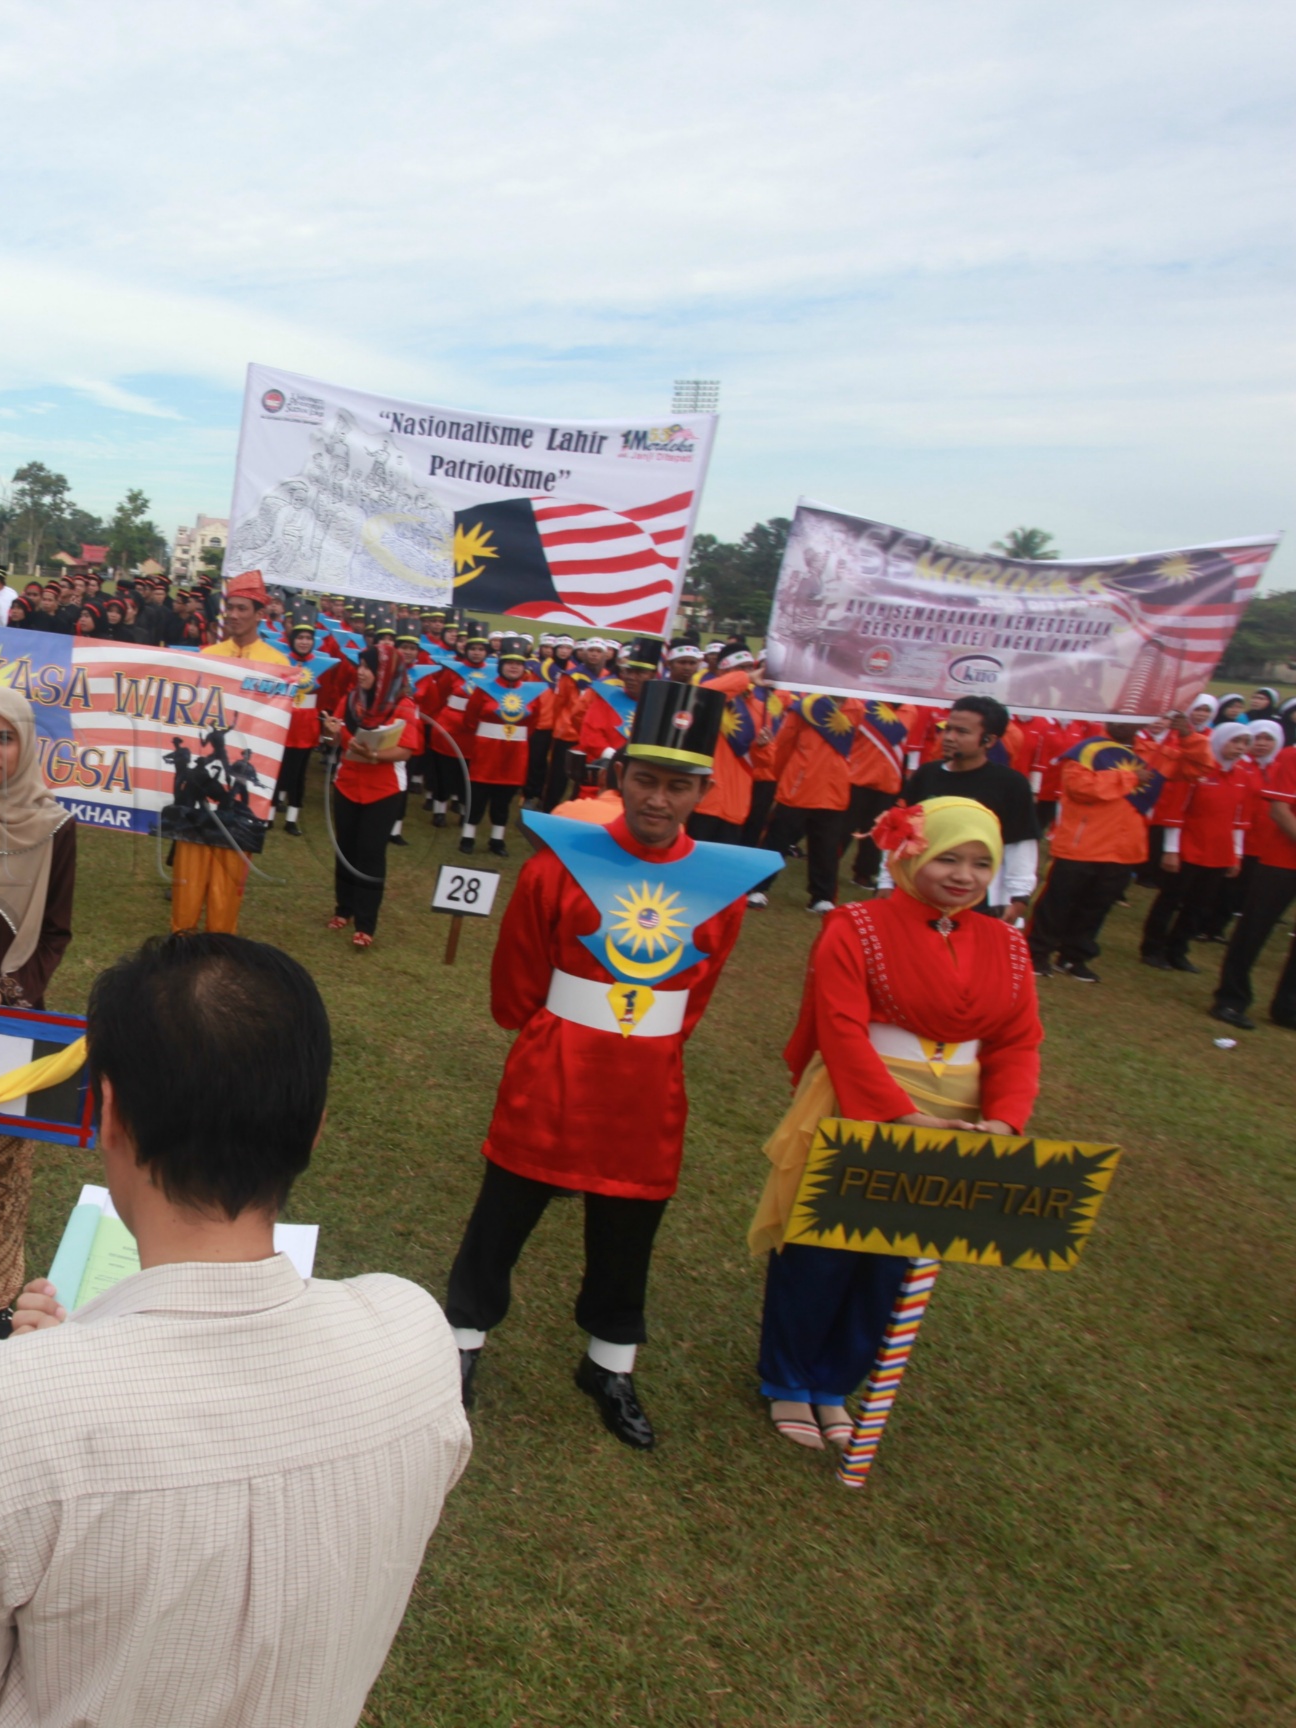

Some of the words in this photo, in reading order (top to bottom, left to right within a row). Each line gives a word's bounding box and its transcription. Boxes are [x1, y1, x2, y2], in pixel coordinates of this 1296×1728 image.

[547, 428, 608, 454] Lahir
[112, 671, 230, 730] WIRA
[70, 803, 131, 828] KHAR
[446, 875, 480, 904] 28
[839, 1167, 1073, 1219] PENDAFTAR
